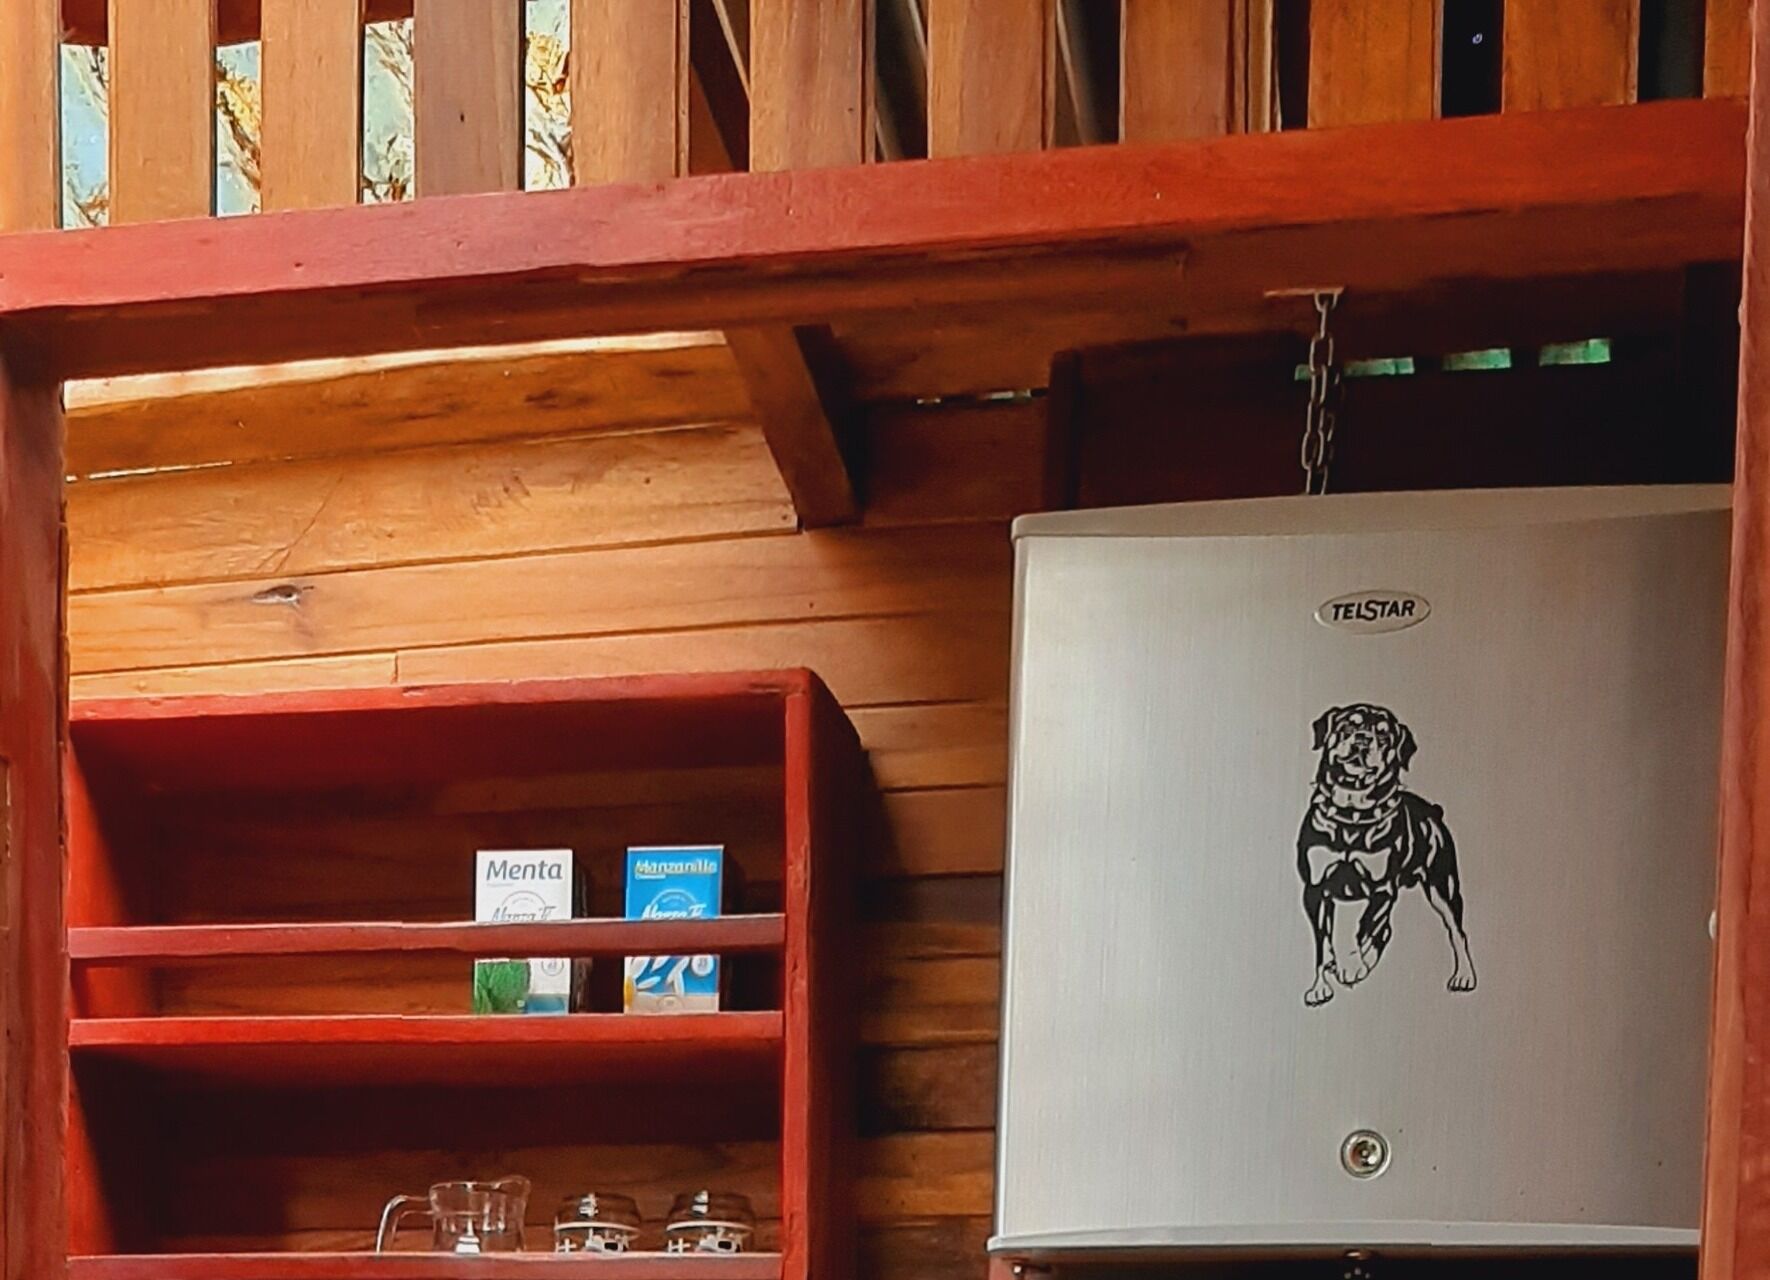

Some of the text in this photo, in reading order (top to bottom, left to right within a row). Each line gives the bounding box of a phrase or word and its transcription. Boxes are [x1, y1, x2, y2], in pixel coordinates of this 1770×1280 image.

[1332, 599, 1416, 622] TELSTAR
[485, 859, 564, 881] Menta
[634, 858, 718, 875] Manzanilla
